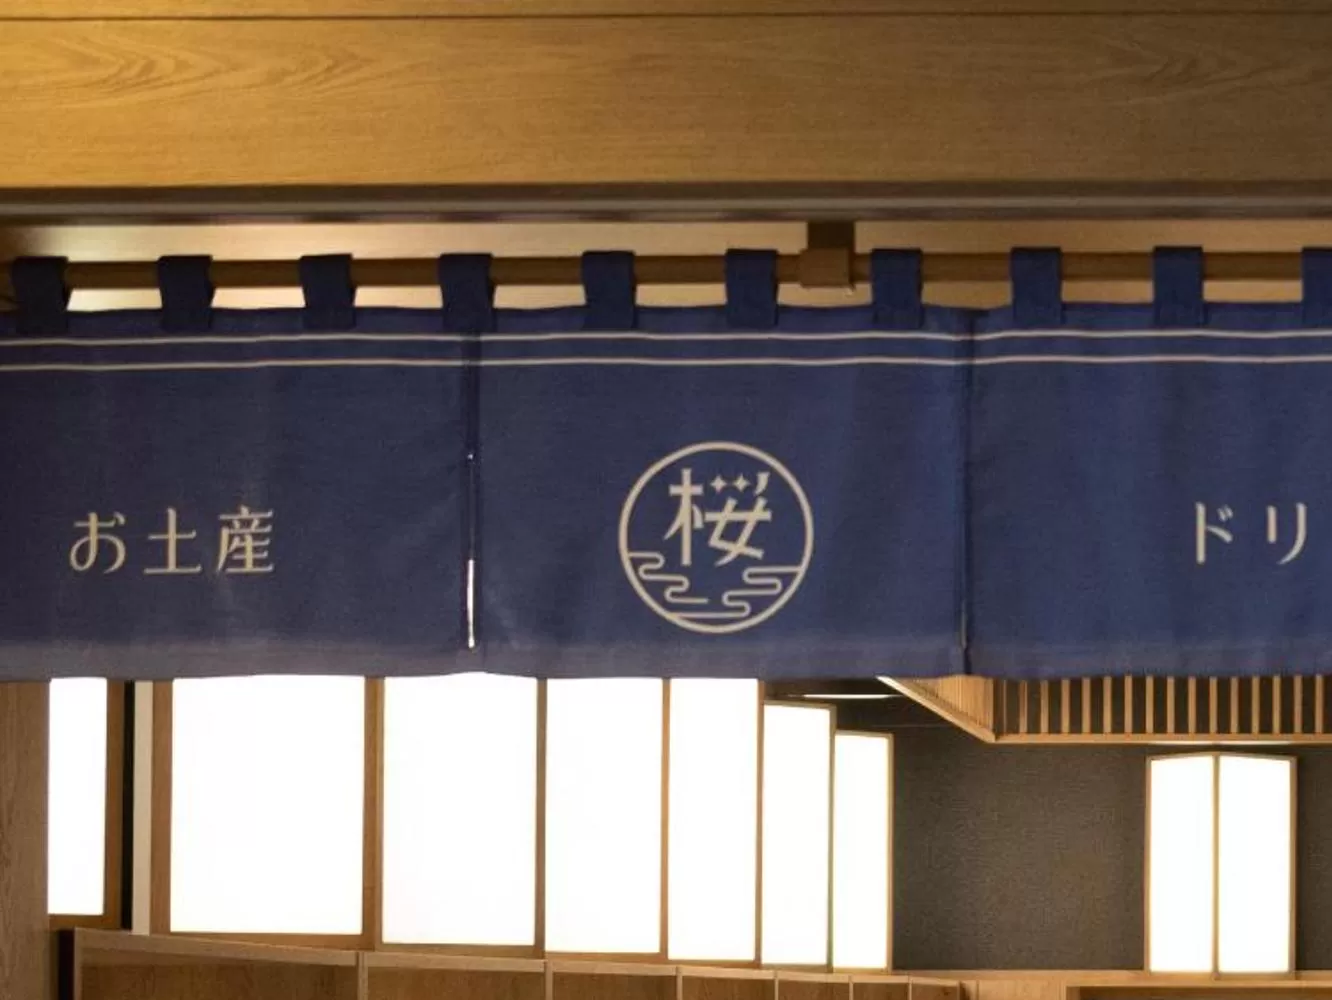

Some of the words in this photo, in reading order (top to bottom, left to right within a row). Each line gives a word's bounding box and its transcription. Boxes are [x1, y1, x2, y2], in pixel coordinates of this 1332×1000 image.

[69, 505, 274, 574] お土産
[663, 467, 773, 567] 桜
